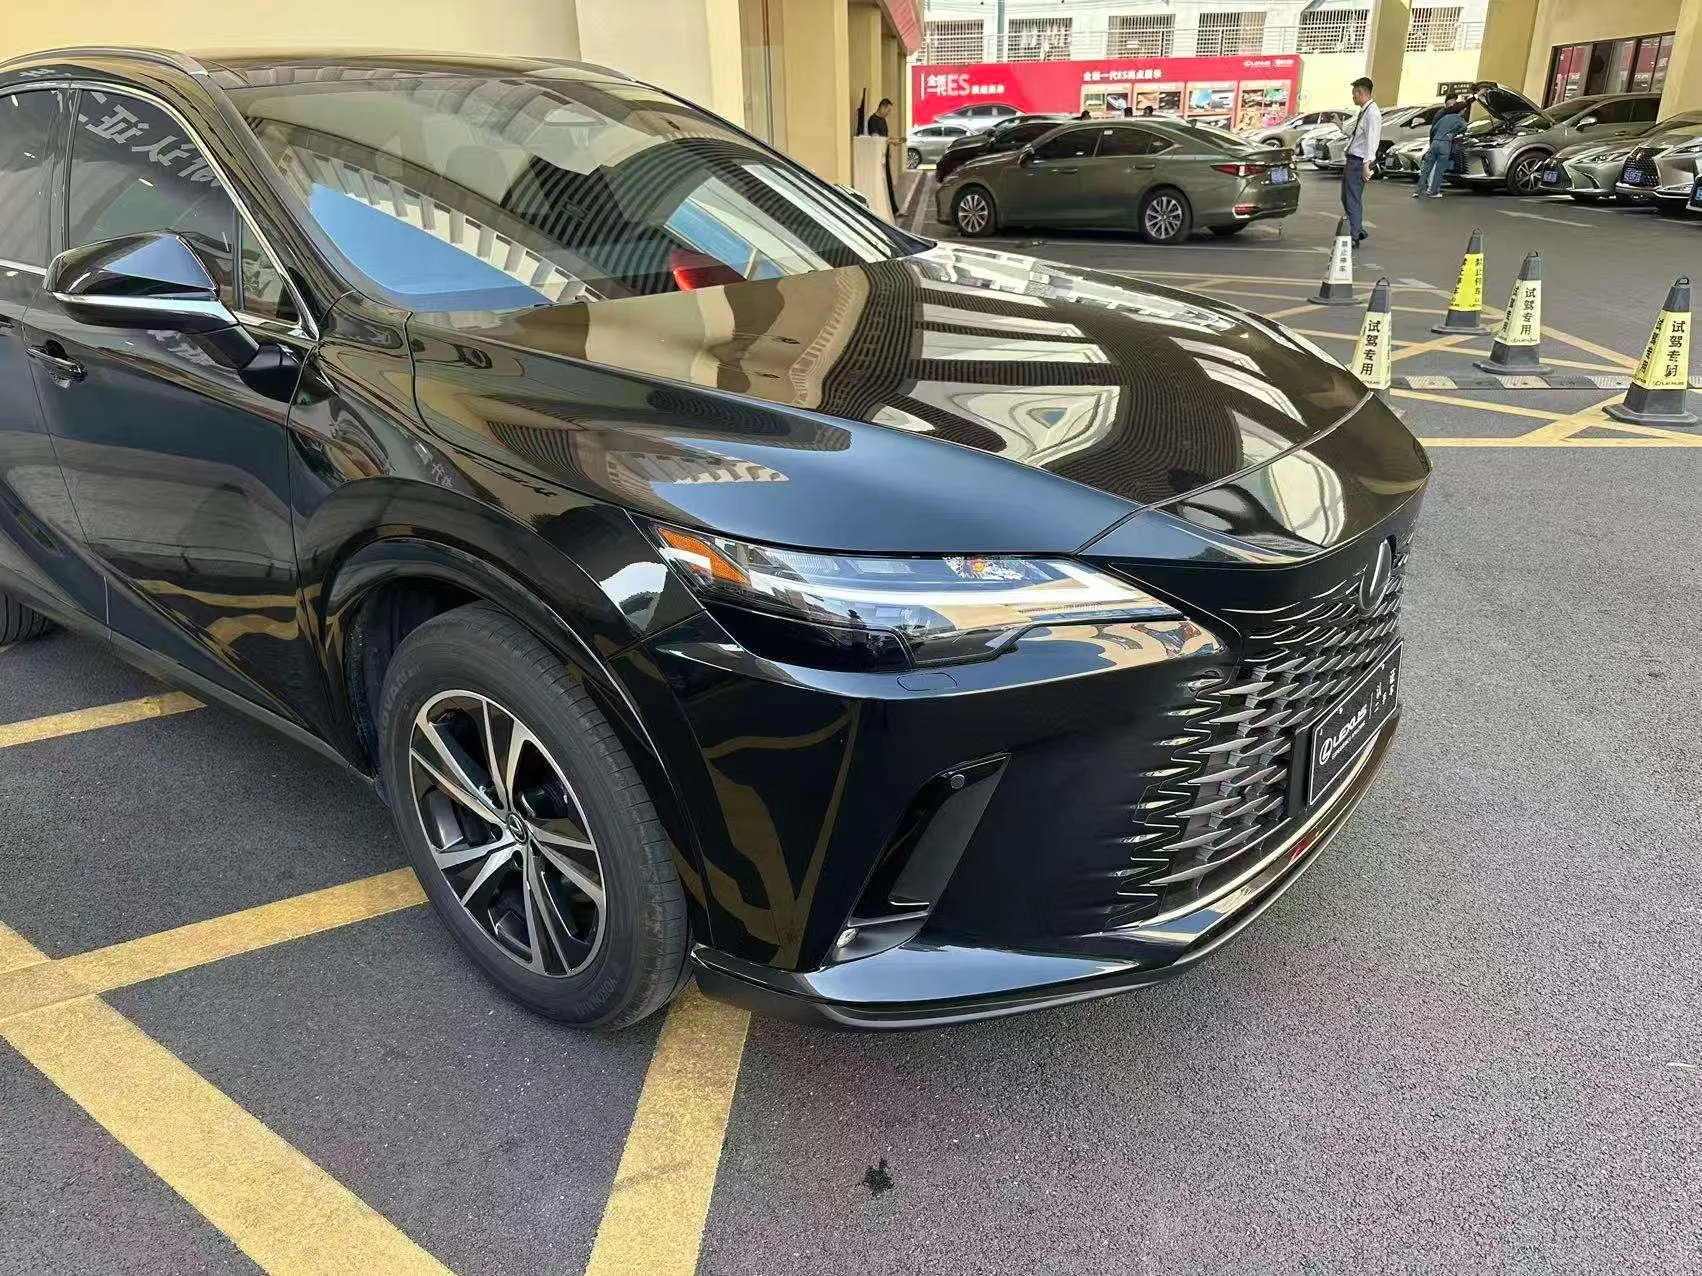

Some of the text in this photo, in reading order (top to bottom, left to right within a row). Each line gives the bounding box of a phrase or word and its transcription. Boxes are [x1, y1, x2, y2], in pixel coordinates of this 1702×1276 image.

[948, 73, 970, 96] ES
[1441, 85, 1448, 94] P
[1520, 287, 1536, 335] 试驾专用
[1361, 320, 1381, 376] 试驾专用
[1332, 703, 1368, 748] LEXUS
